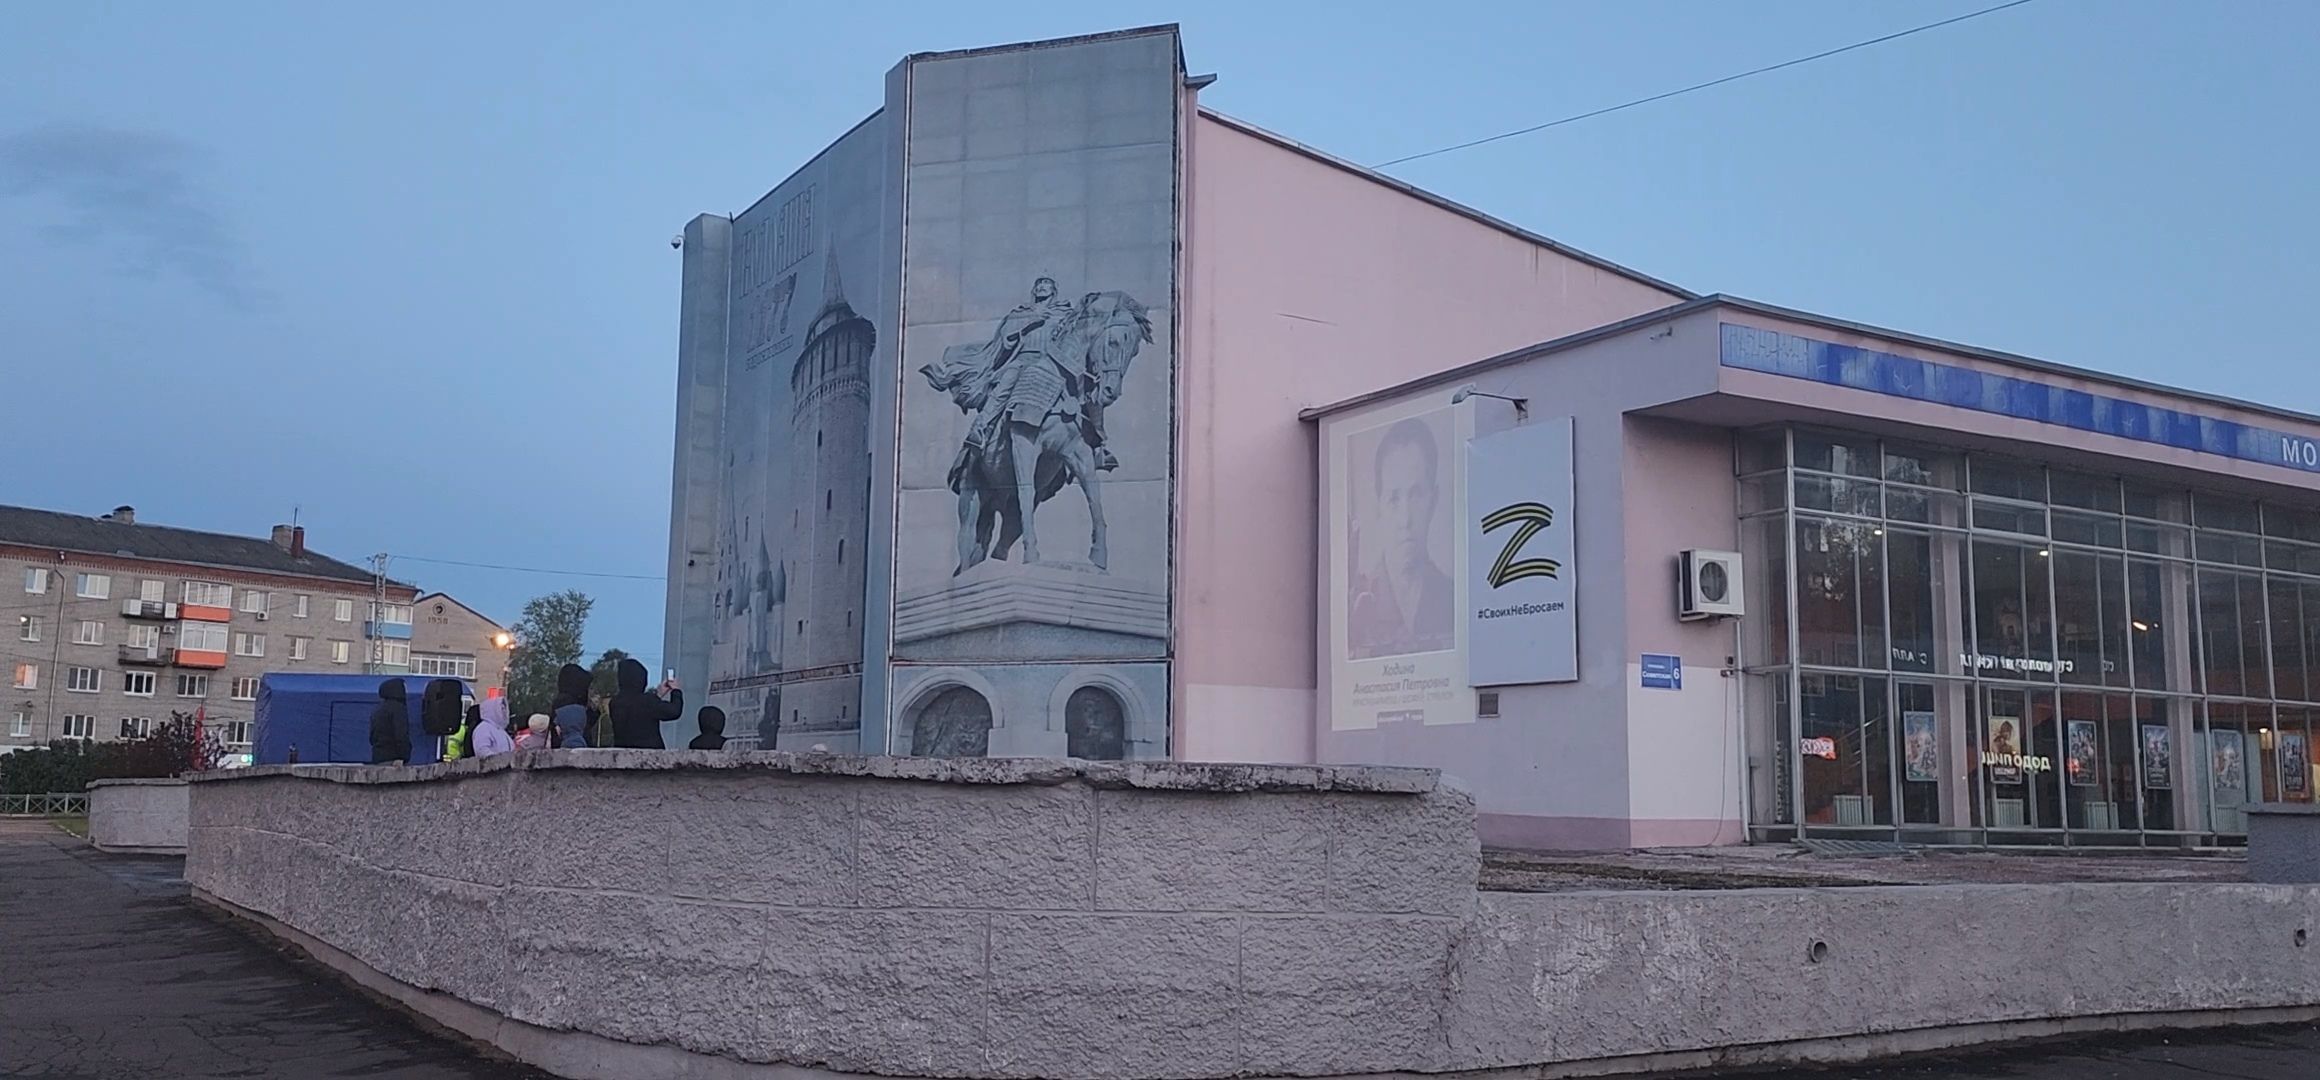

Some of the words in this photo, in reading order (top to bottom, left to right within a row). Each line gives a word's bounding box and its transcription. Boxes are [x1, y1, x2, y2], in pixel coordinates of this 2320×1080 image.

[2282, 437, 2317, 466] МО
[1481, 502, 1562, 589] Z
[1478, 602, 1564, 619] #СвоихНеБросаем
[1673, 667, 1680, 680] 6
